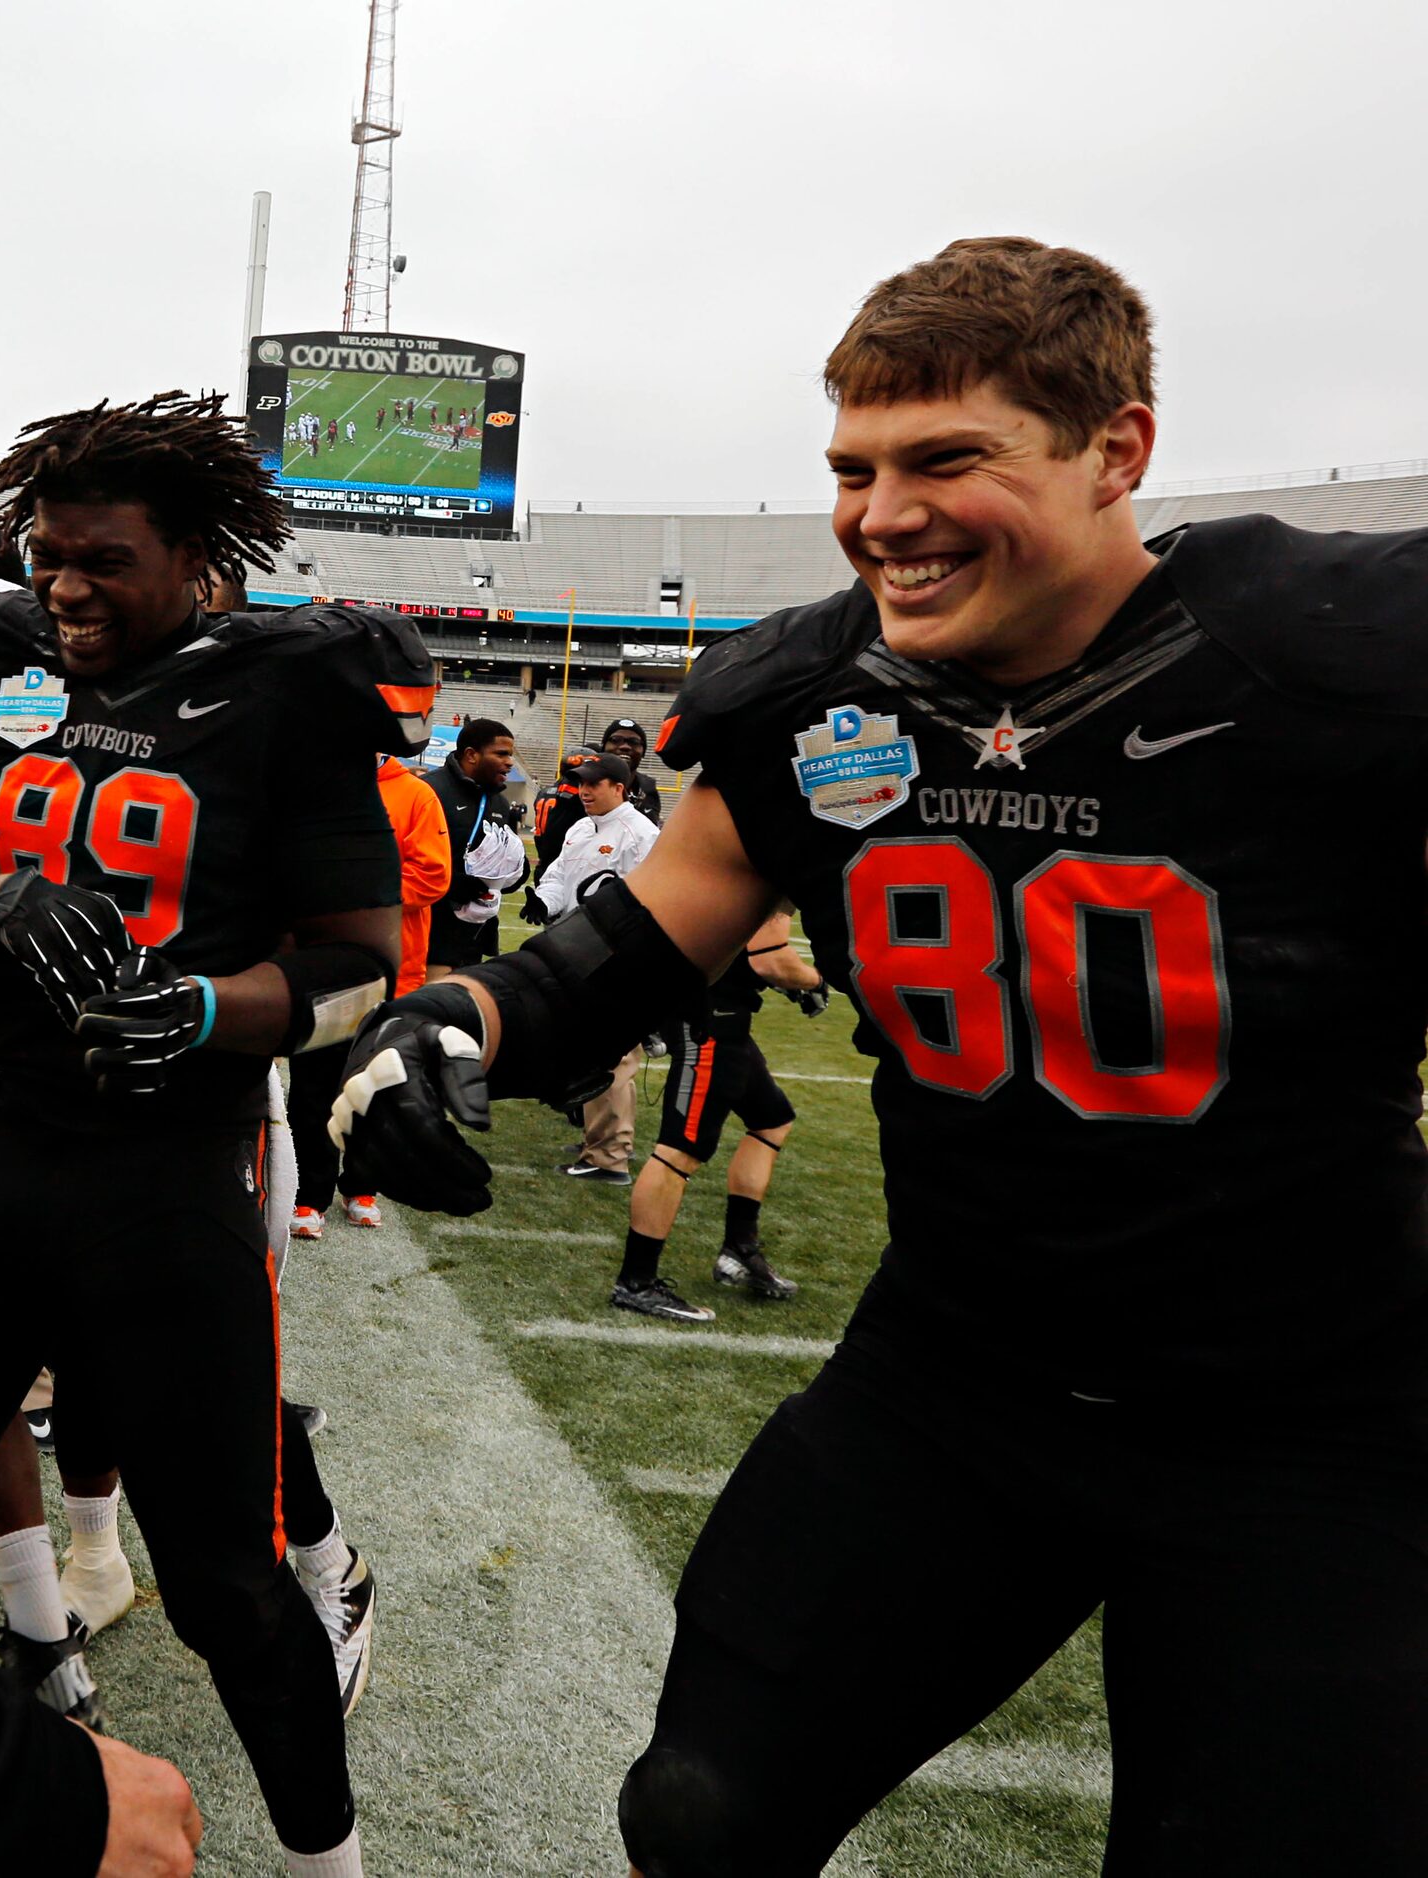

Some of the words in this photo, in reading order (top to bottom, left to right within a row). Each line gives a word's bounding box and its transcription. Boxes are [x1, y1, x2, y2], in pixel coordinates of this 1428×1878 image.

[339, 335, 396, 348] WELCOME
[398, 338, 415, 349] TO
[416, 340, 440, 350] THE
[289, 344, 401, 374] COTTON
[404, 352, 484, 378] BOWL
[293, 488, 346, 502] PURDUE
[350, 492, 360, 502] 14
[498, 609, 514, 620] 40
[32, 699, 62, 707] DALLAS
[62, 723, 156, 759] COWBOYS
[993, 727, 1014, 753] C
[803, 757, 840, 775] HEART
[854, 747, 903, 764] DALLAS
[838, 765, 865, 777] BOWL
[917, 788, 1101, 838] COWBOYS
[843, 835, 1232, 1126] 80
